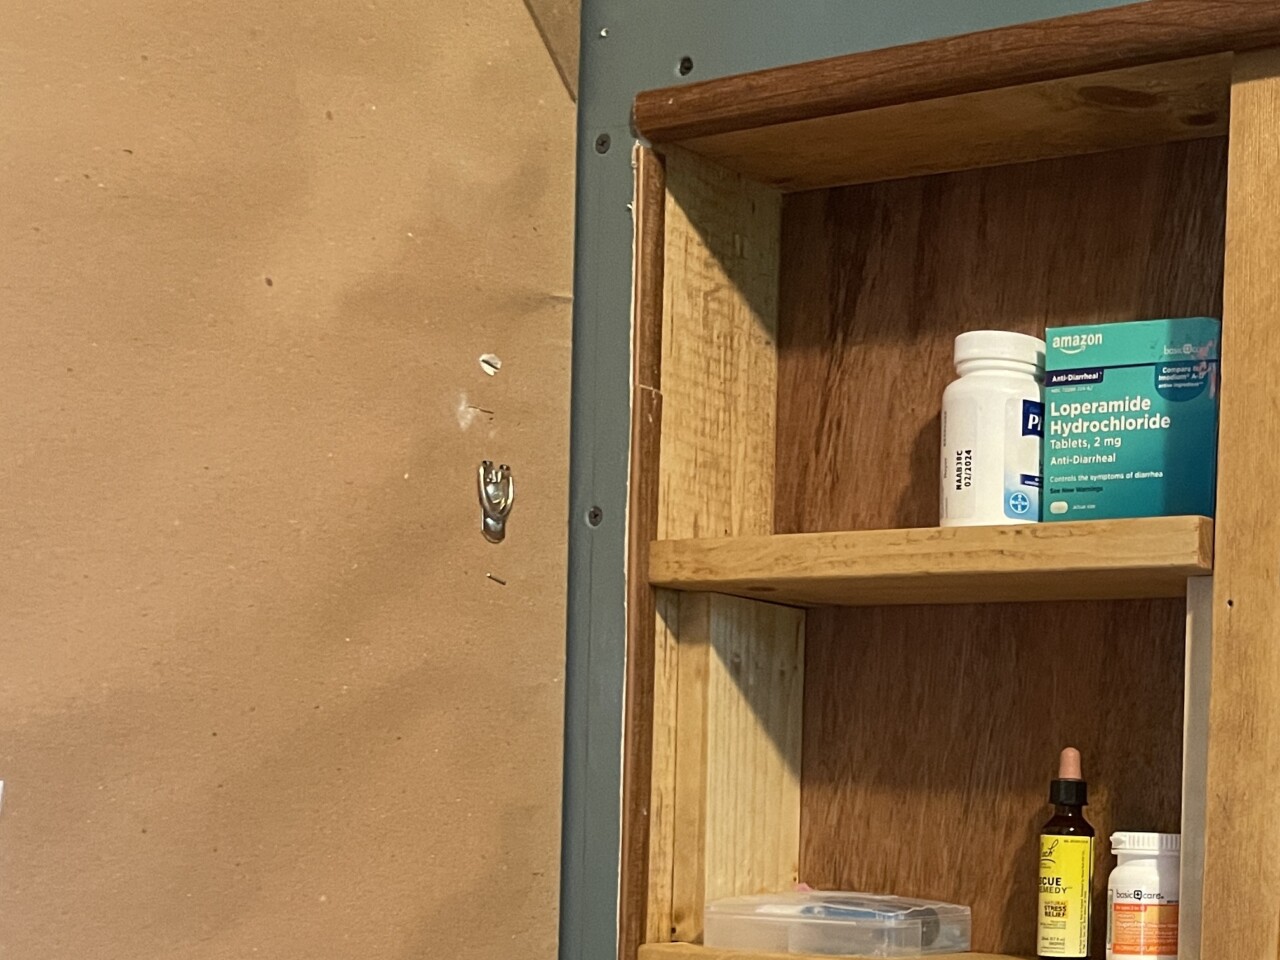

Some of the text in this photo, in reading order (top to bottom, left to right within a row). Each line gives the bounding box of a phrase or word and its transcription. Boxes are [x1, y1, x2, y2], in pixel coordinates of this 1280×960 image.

[1052, 333, 1103, 352] amazon
[1052, 372, 1099, 383] Anti-Diarrheal
[1050, 396, 1151, 418] Loperamide
[1050, 413, 1171, 437] Hydrochloride
[1050, 437, 1122, 449] Tablets, 2 mg
[1050, 453, 1116, 466] Anti-Diarrheal
[964, 450, 972, 487] 02/2024
[1090, 473, 1125, 482] symptoms
[1126, 471, 1133, 479] of
[1135, 471, 1164, 479] diarrhea
